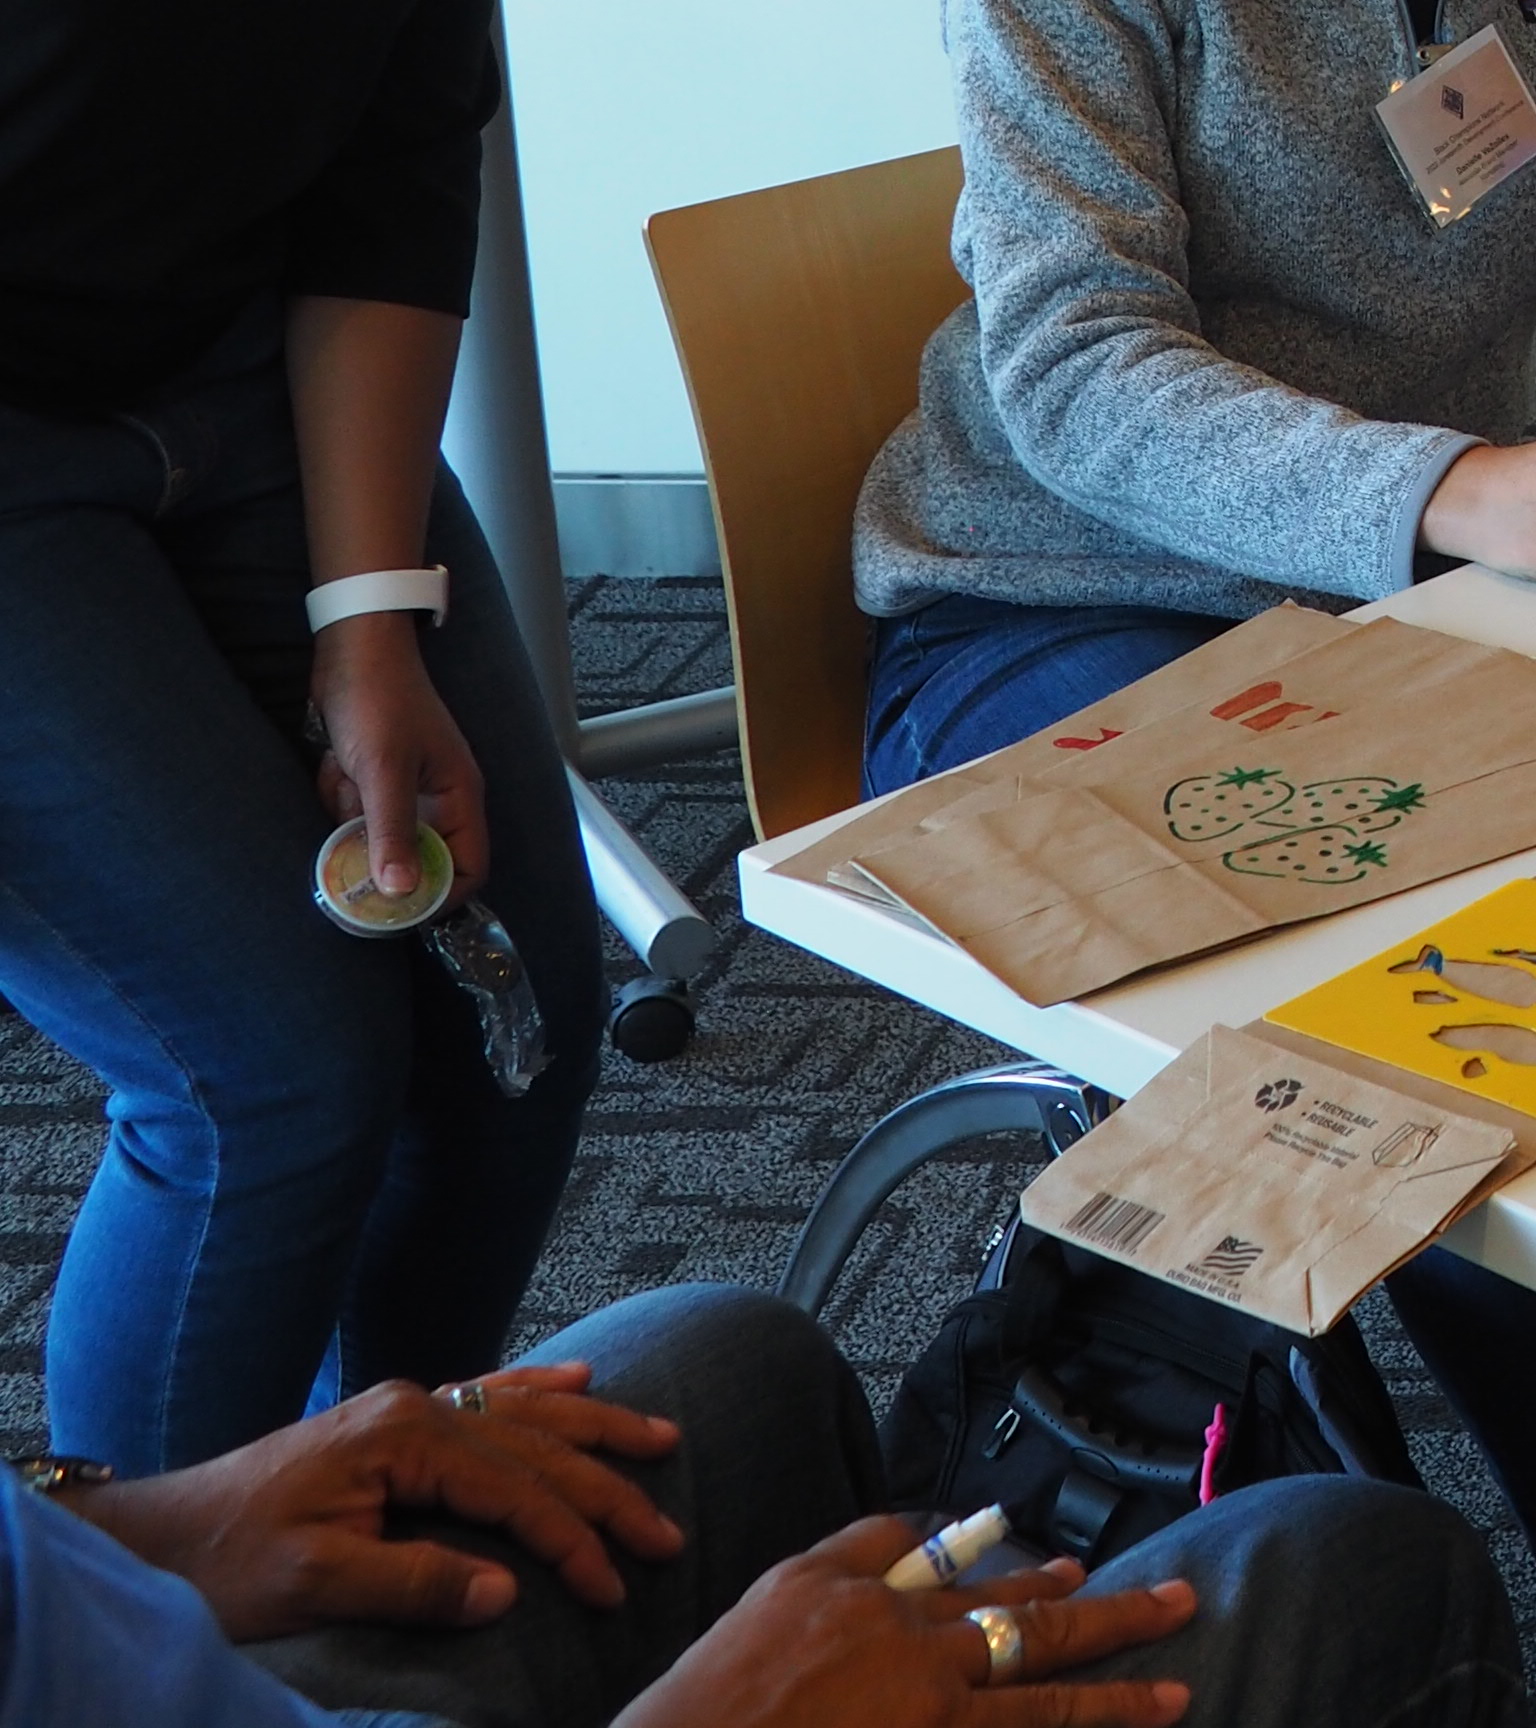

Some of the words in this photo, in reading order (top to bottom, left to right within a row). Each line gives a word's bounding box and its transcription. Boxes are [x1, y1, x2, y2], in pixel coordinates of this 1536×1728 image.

[1307, 1112, 1355, 1138] REUSABLE
[1320, 1101, 1378, 1129] RECYCLABLE
[1264, 1132, 1288, 1146] Please
[1190, 1278, 1208, 1291] BAG
